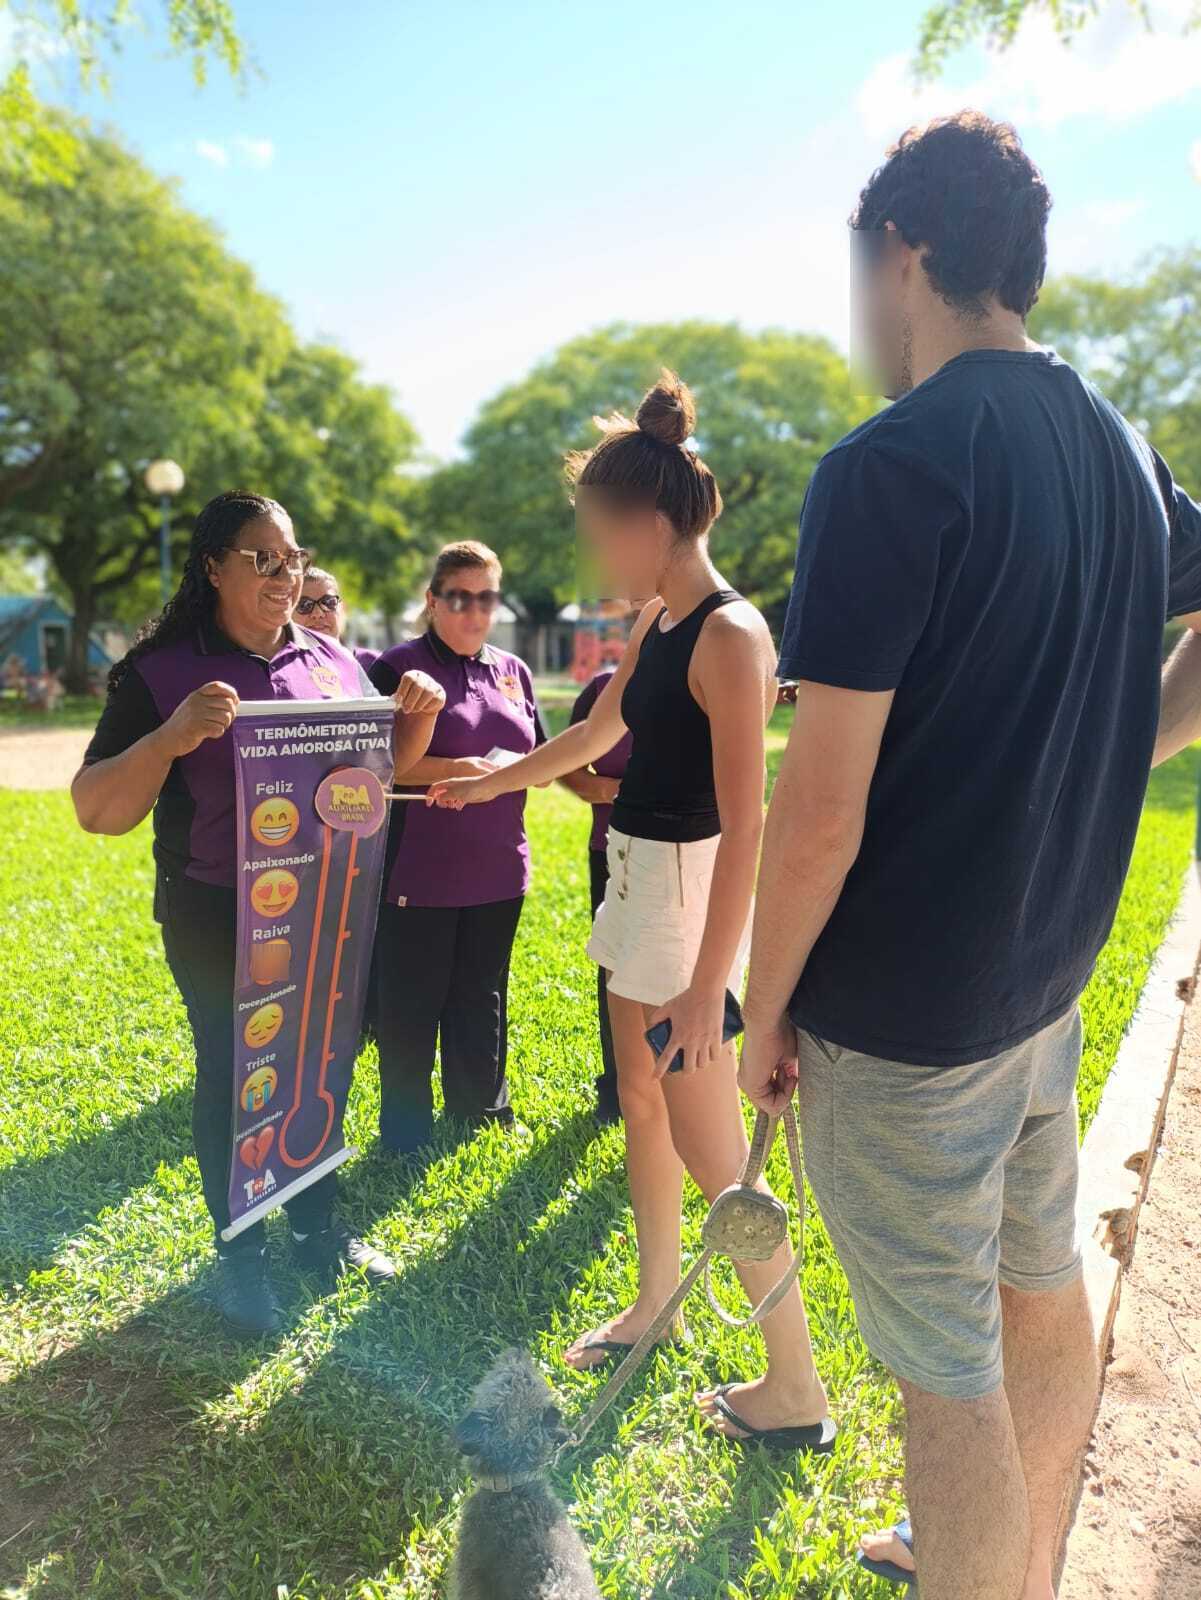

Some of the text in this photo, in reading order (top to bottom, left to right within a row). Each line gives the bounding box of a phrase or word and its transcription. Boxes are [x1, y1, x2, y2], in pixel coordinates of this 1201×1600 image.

[254, 721, 379, 741] TERMÔMETRO DA
[239, 737, 391, 758] VIDA AMOROSA (TVA)
[255, 780, 294, 796] Feliz
[242, 852, 316, 872] Apaixonado
[252, 924, 291, 941] Raiva
[246, 1053, 277, 1072] Triste
